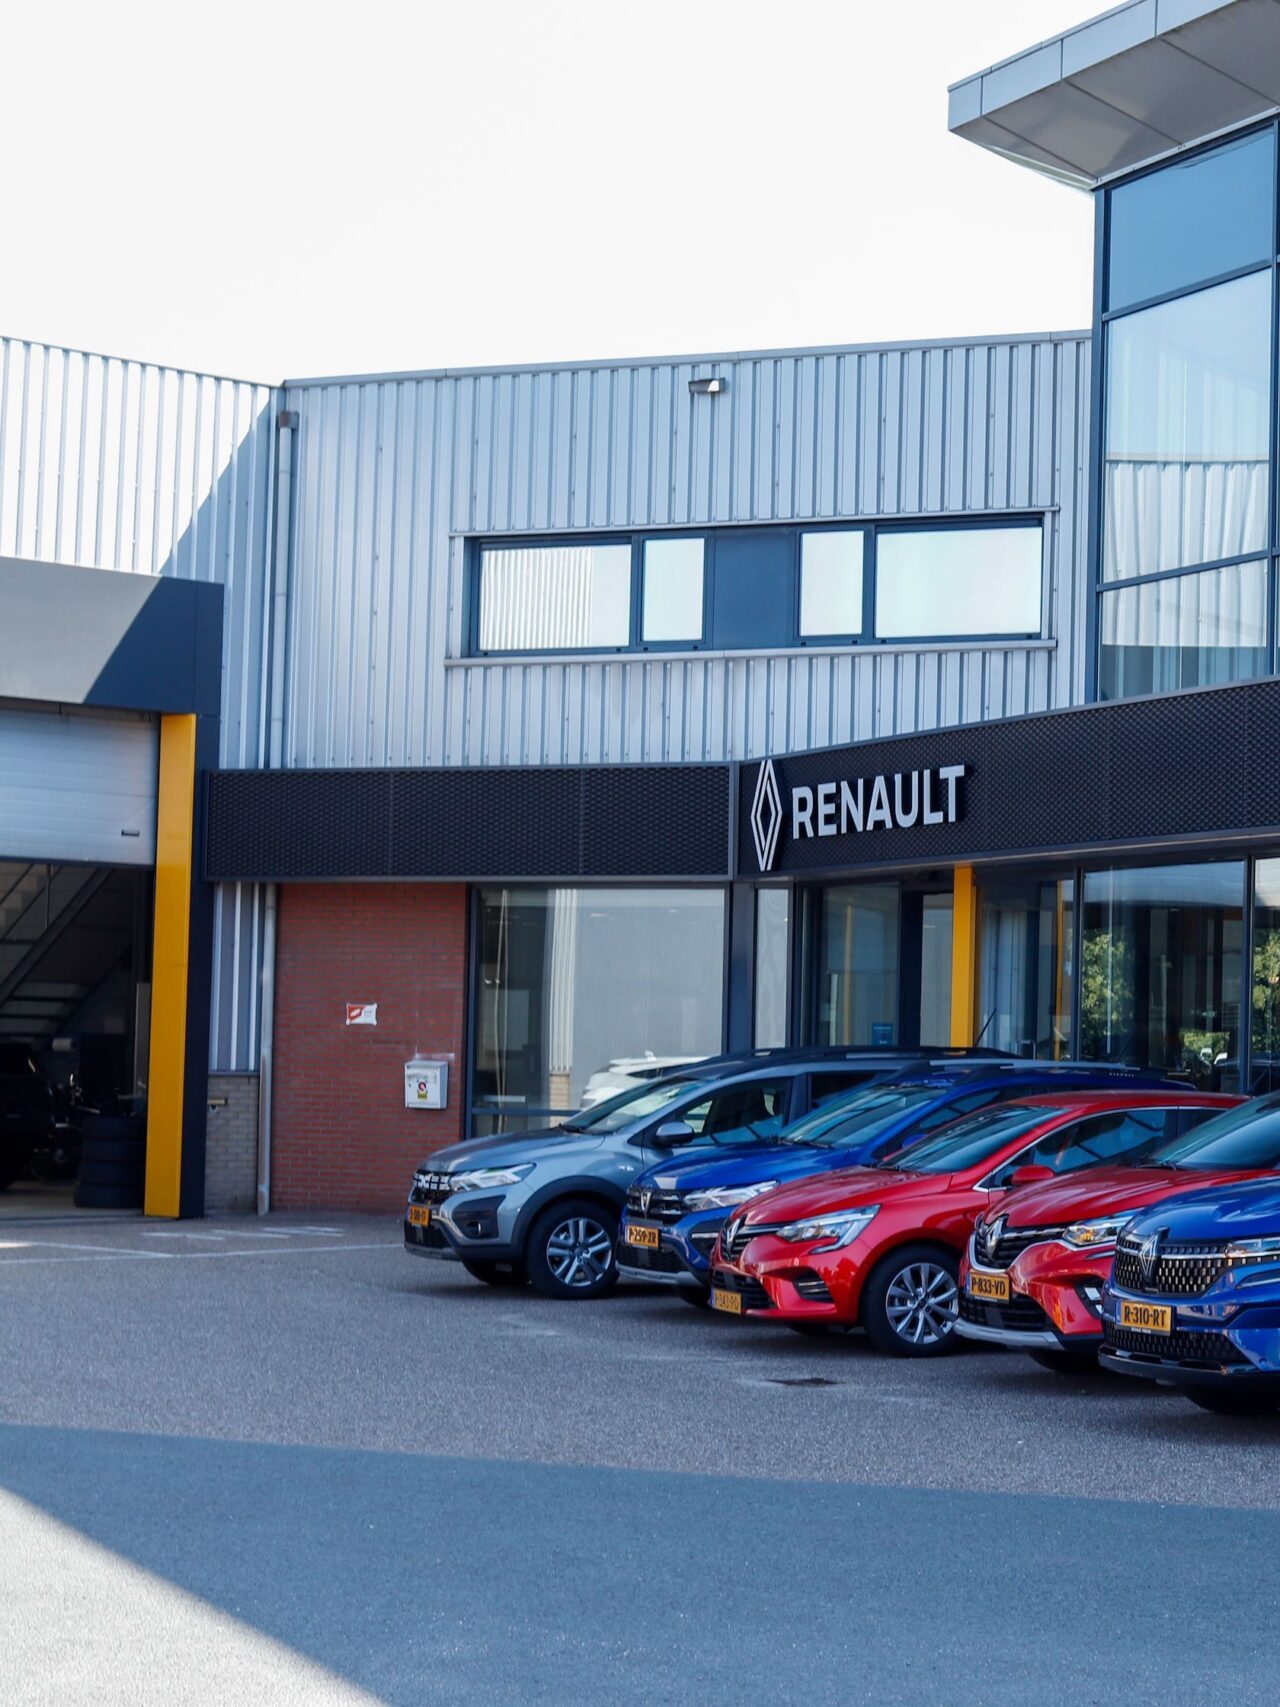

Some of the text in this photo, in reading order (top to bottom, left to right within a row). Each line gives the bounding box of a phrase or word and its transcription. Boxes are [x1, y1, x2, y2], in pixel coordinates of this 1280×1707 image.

[792, 764, 965, 840] RENAULT
[971, 1276, 1006, 1296] P-833-VD
[1124, 1305, 1166, 1327] R-310-RT
